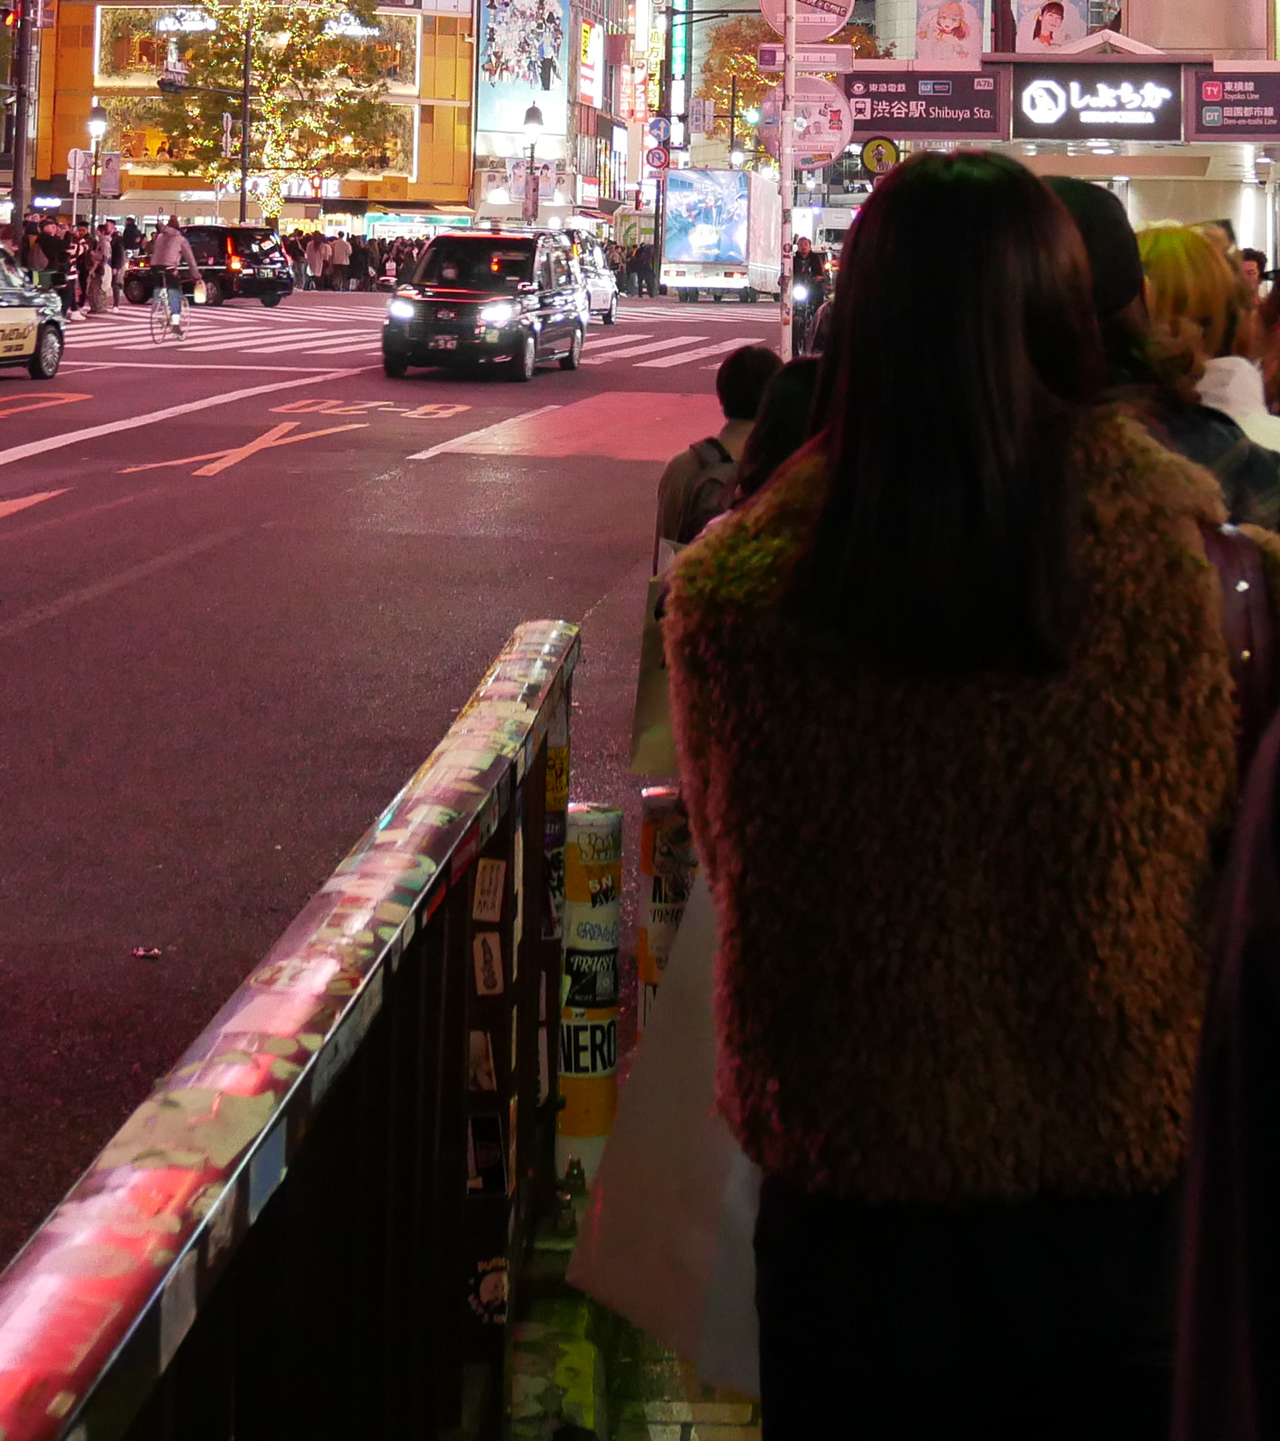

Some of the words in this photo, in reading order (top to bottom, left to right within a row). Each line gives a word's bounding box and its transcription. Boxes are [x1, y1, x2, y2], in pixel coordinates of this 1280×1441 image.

[868, 83, 907, 93] 東急電鉄
[975, 80, 993, 89] A7b
[1205, 86, 1219, 96] TY
[1223, 81, 1255, 92] 東横線
[1246, 92, 1260, 100] Line
[872, 100, 926, 119] 渋谷駅
[928, 107, 971, 122] Shibuya
[973, 107, 994, 119] Sta.
[1223, 106, 1275, 117] 田園都市線
[1205, 113, 1220, 122] DT
